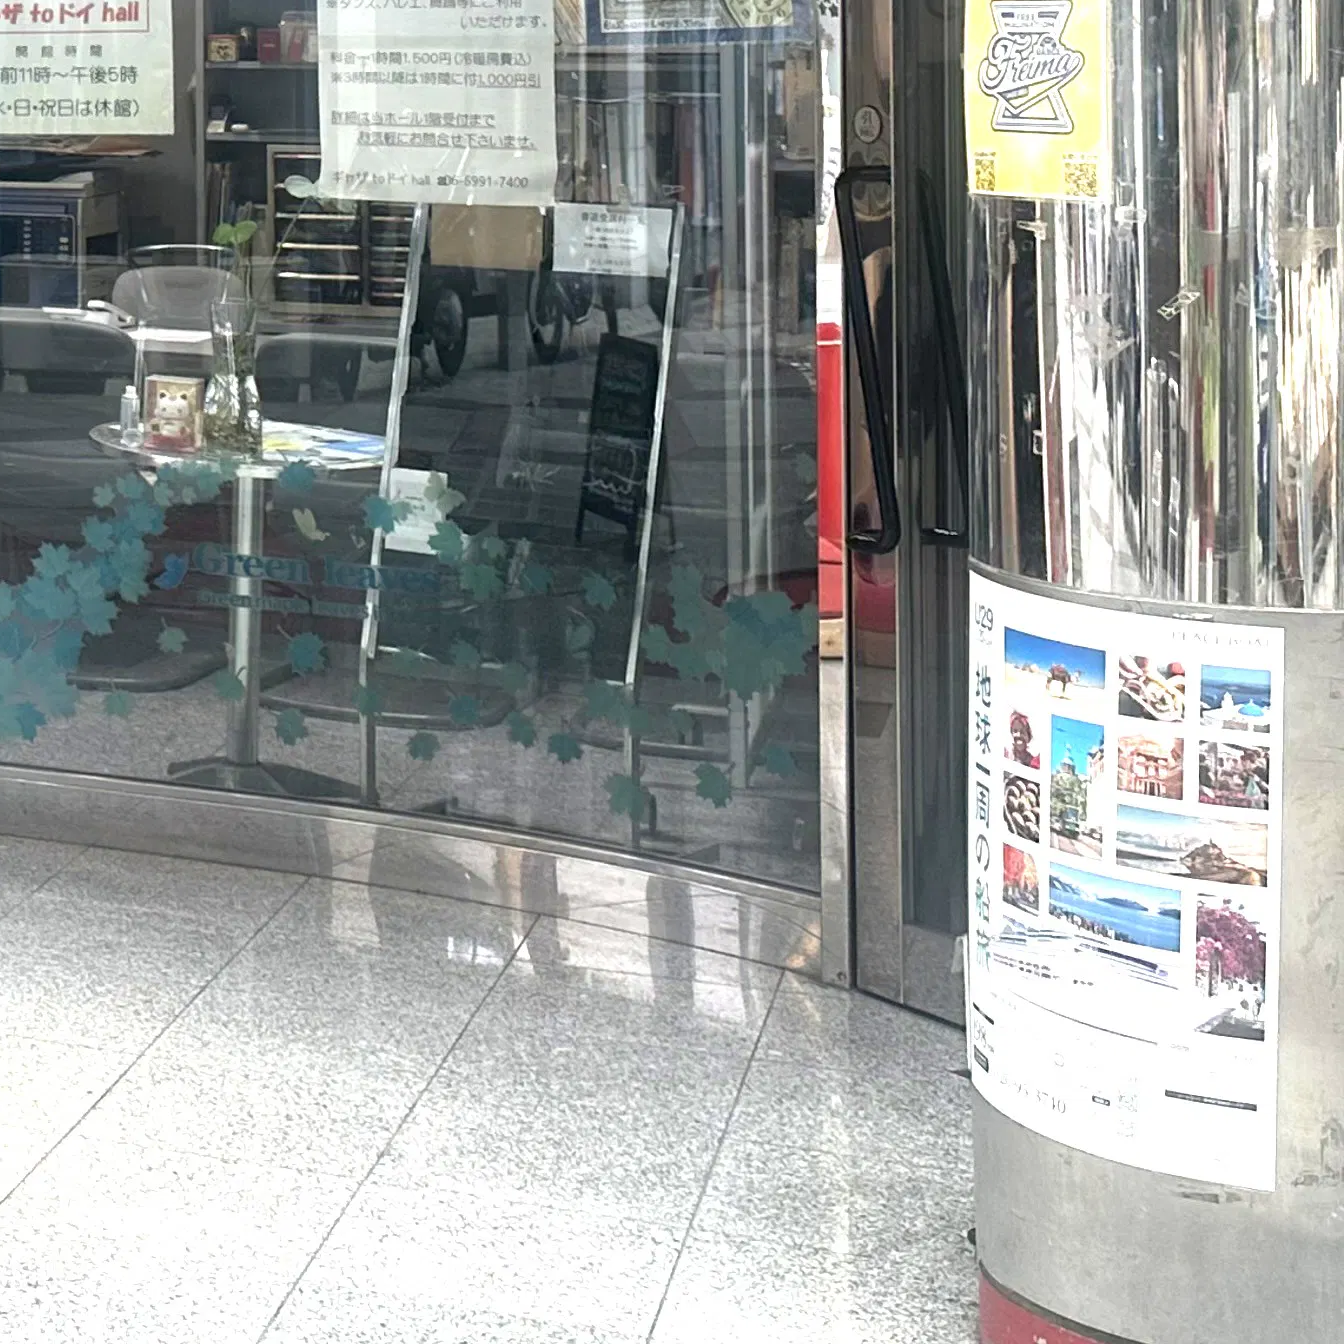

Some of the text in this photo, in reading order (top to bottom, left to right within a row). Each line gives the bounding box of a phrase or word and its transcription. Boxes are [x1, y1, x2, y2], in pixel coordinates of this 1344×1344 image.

[30, 4, 54, 24] to
[59, 3, 94, 24] ドイ
[101, 1, 140, 23] hall
[412, 172, 431, 186] hall
[195, 542, 441, 592] Green leaves
